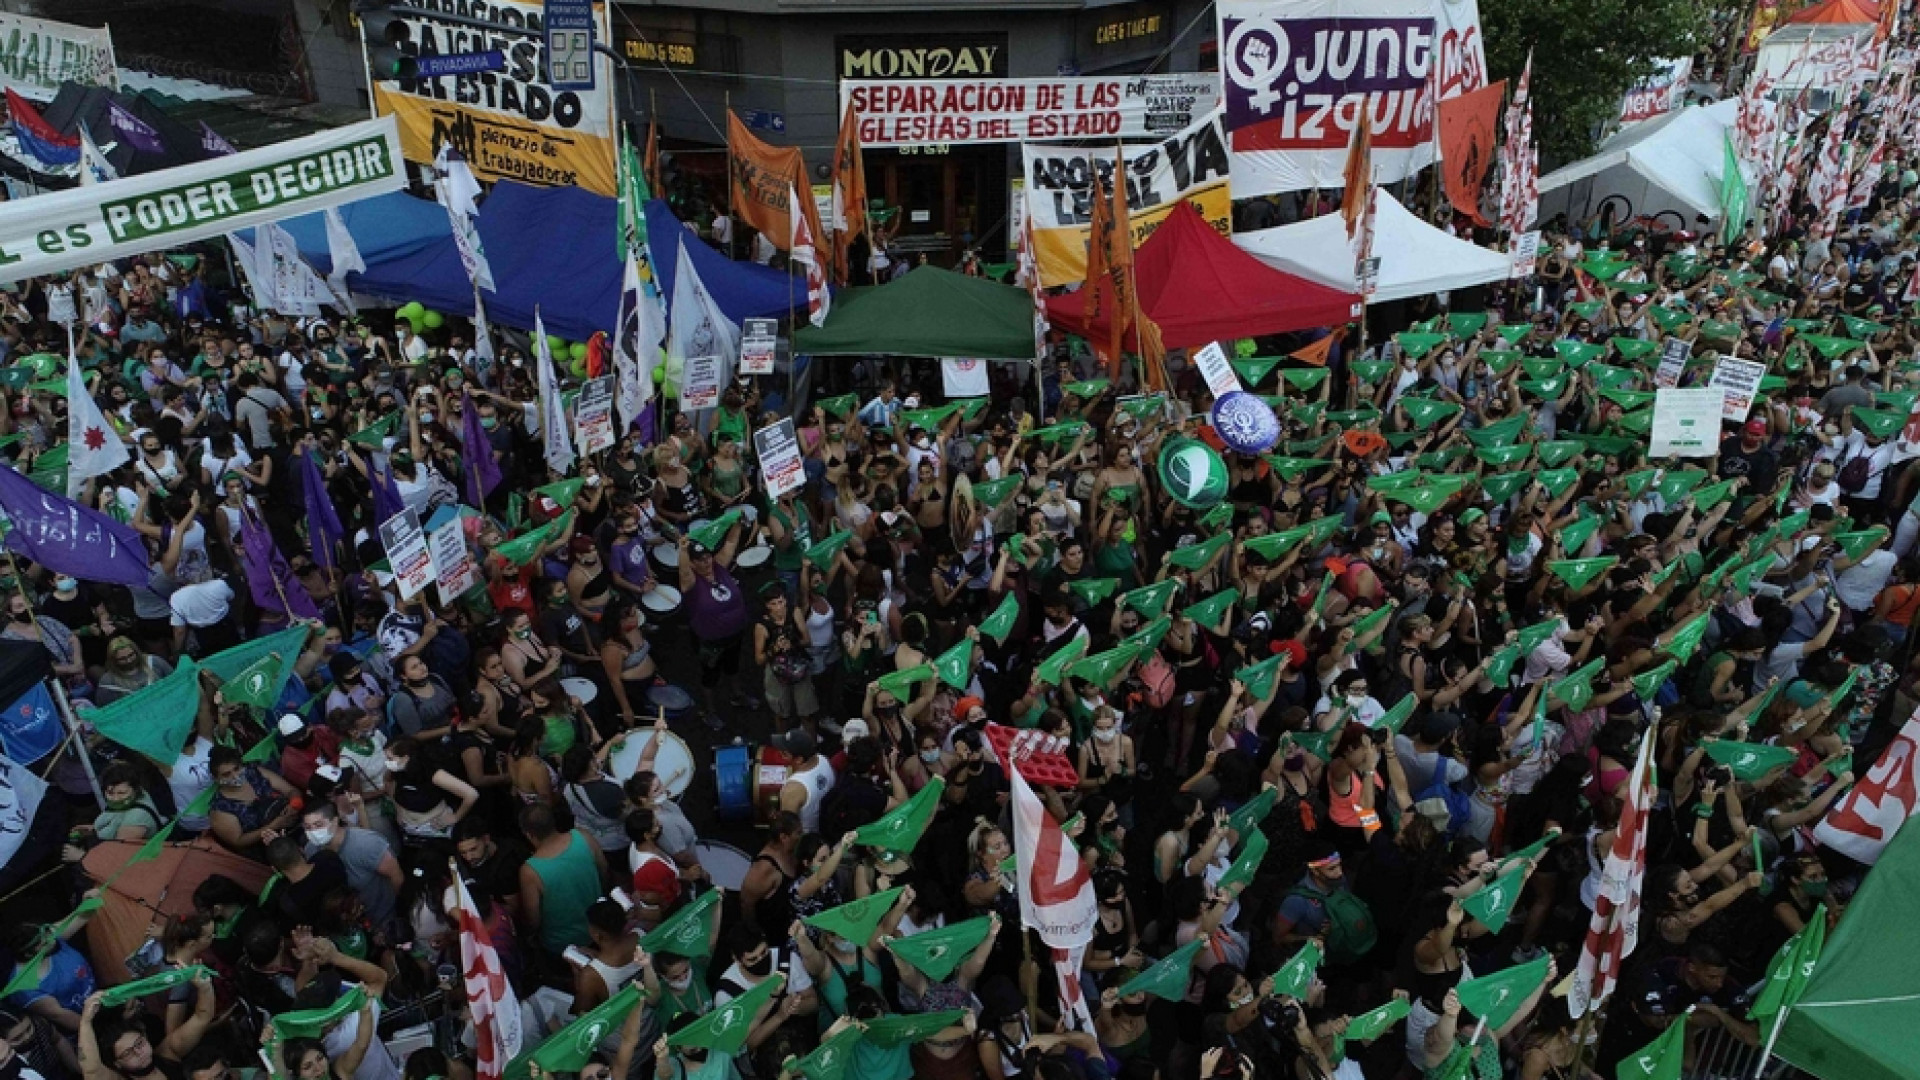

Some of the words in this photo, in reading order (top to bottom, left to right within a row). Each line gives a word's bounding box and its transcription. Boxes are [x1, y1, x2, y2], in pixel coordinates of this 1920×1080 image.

[430, 56, 490, 74] RIVADAVIA
[843, 45, 998, 77] MONDAY
[455, 73, 581, 128] ESTADO
[1036, 83, 1066, 111] DE
[1075, 82, 1120, 110] LAS
[977, 119, 1018, 139] DEL
[1028, 111, 1123, 137] ESTADO
[481, 128, 538, 153] plenario
[541, 141, 557, 157] de
[1165, 121, 1230, 192] YA
[482, 149, 577, 186] trabajadoras
[107, 181, 239, 239] PODER
[252, 141, 387, 205] DECIDIR
[1053, 176, 1161, 225] LEAL
[36, 223, 94, 254] es
